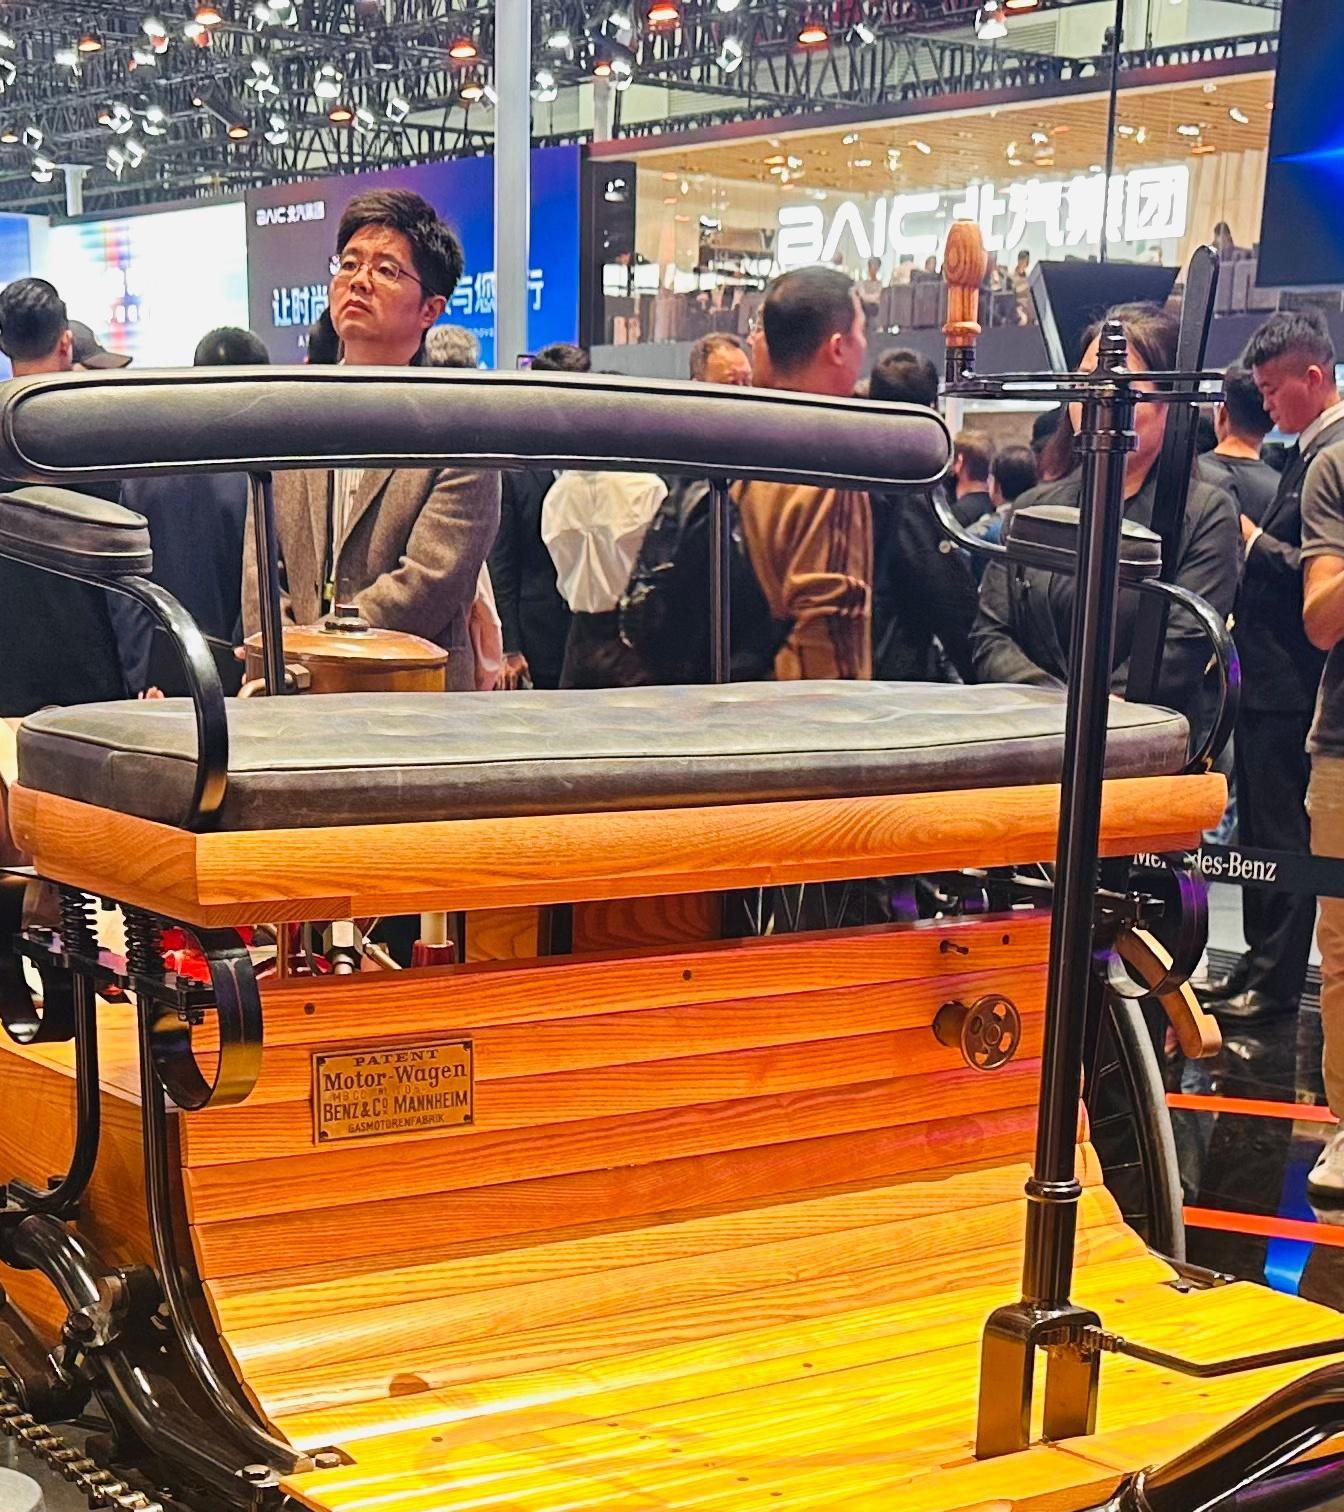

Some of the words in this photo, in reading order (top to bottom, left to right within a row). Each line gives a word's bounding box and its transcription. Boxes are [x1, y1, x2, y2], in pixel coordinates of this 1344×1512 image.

[353, 1049, 440, 1067] PATENT
[393, 1090, 468, 1115] MANNHEIM
[348, 1114, 445, 1134] GASMOTORENFABRIK
